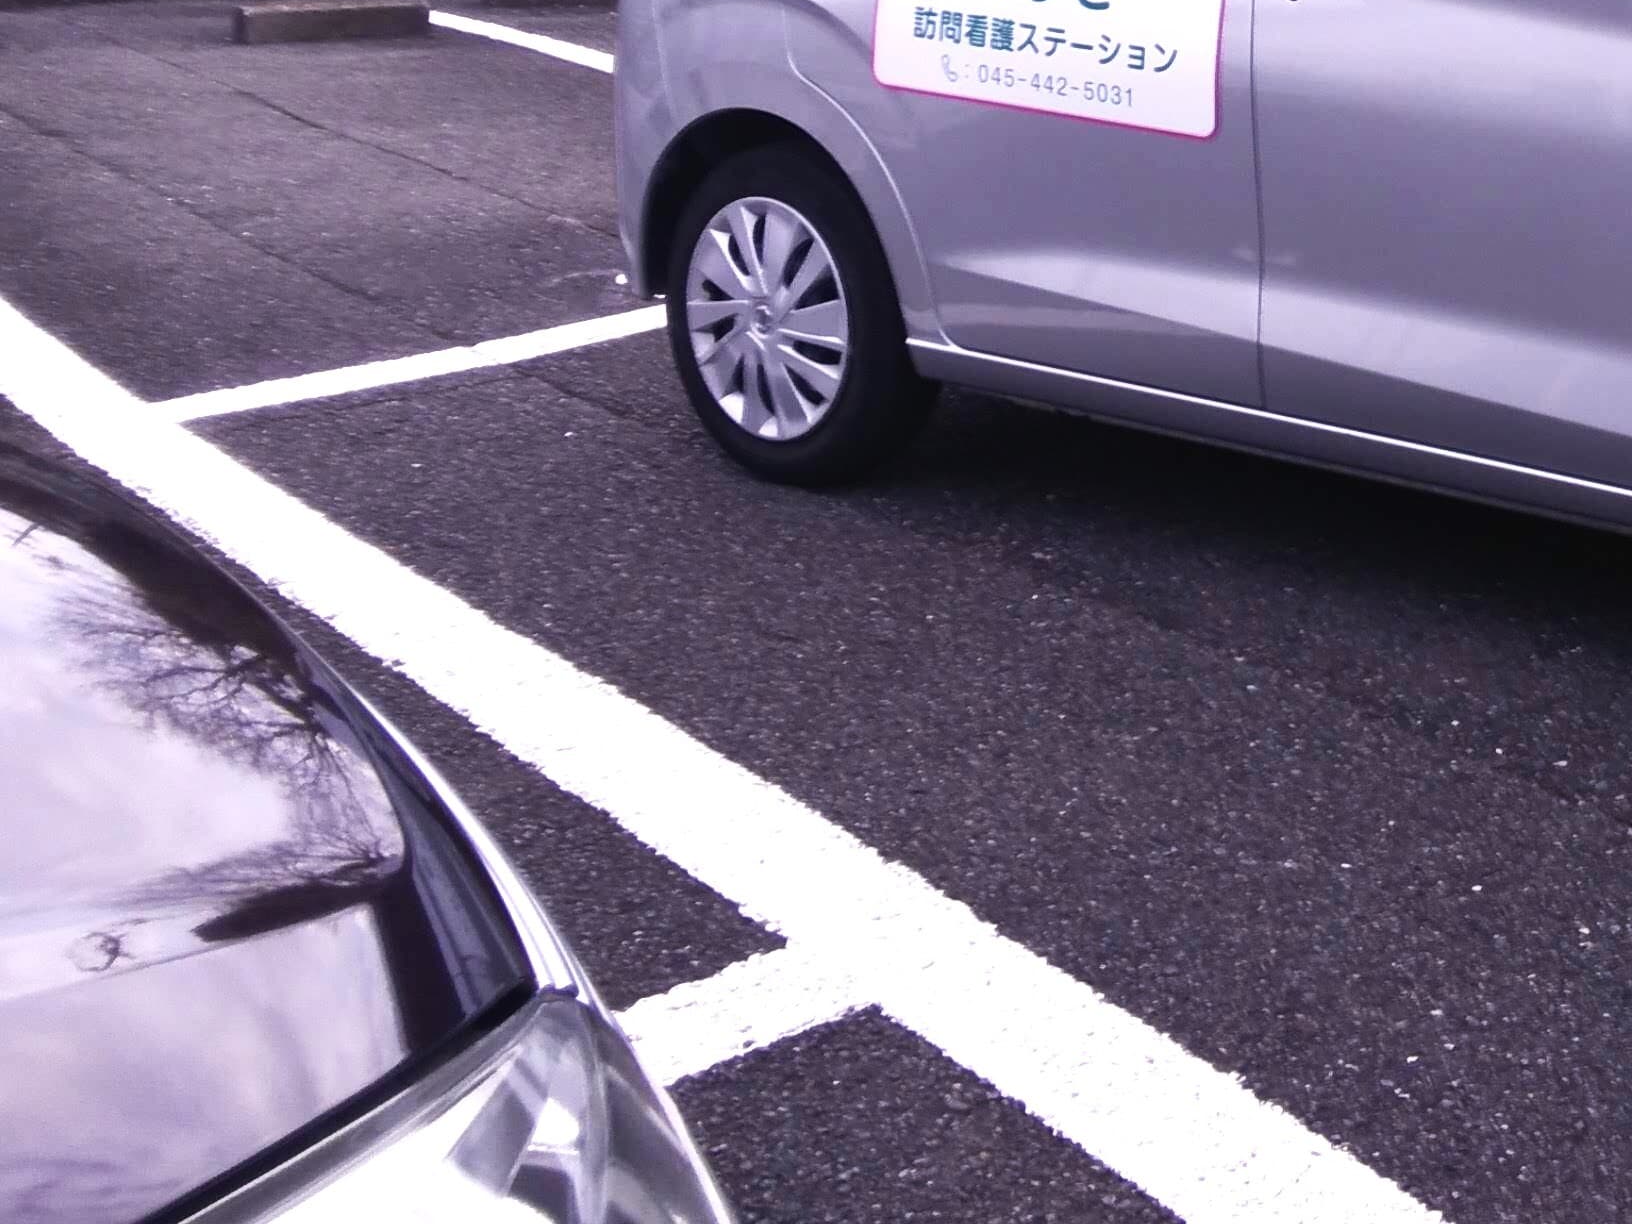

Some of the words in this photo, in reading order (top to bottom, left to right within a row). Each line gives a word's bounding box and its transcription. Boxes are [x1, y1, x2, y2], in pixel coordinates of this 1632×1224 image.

[913, 6, 1178, 73] 訪問看護ステーション
